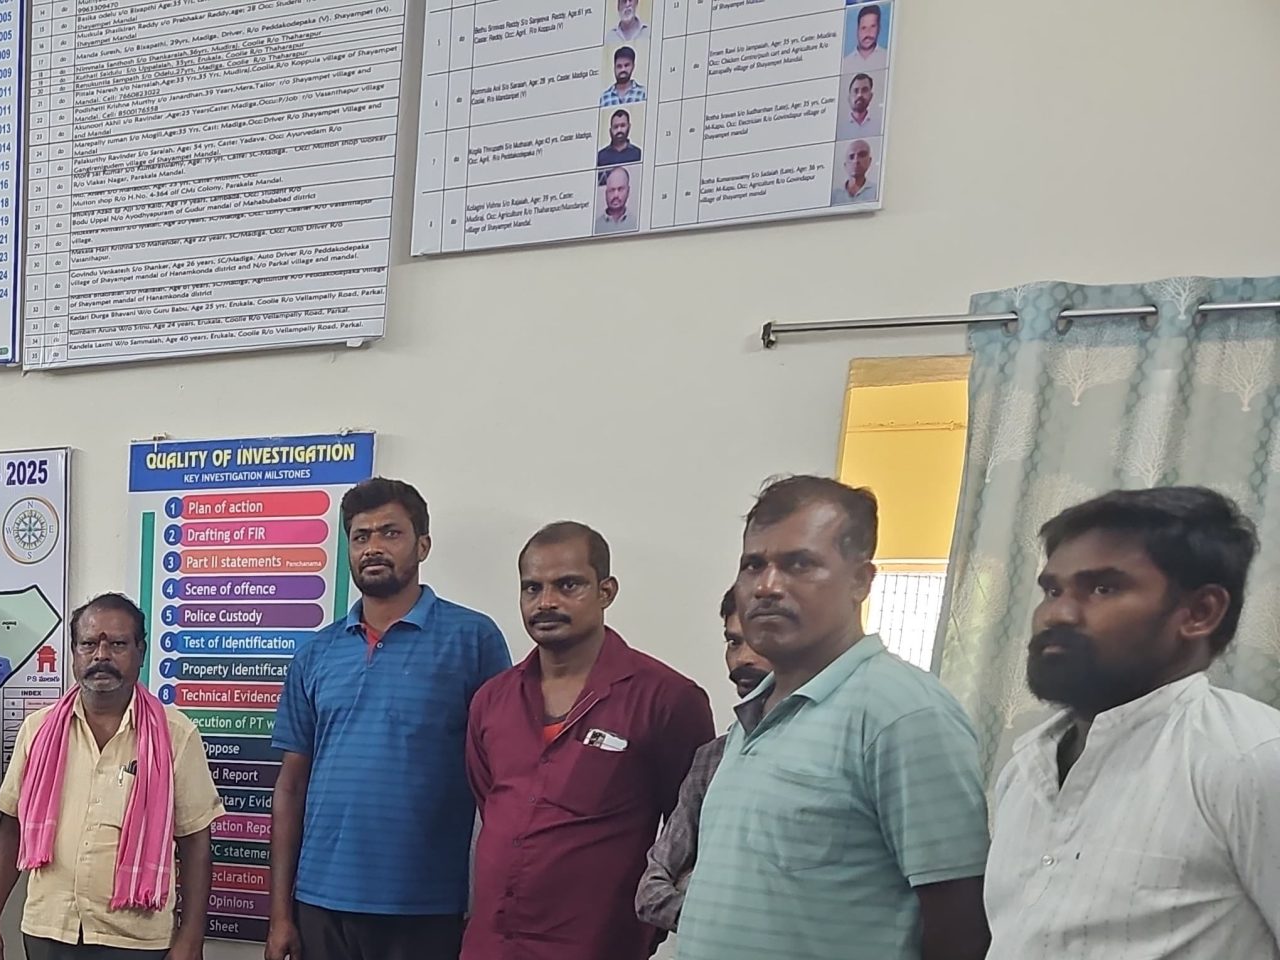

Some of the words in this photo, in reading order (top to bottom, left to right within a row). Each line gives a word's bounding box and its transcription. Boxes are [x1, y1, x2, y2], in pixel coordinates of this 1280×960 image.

[146, 450, 208, 471] QUALITY
[212, 449, 232, 469] OF
[237, 442, 356, 467] INVESTIGATION
[6, 461, 49, 486] 2025
[184, 473, 200, 484] KEY
[202, 471, 263, 483] INVESTIGATION
[265, 469, 312, 480] MILSTONES
[170, 503, 176, 513] 1
[189, 502, 212, 514] Plan
[215, 501, 227, 513] of
[229, 501, 264, 513] action
[168, 530, 176, 541] 2
[188, 529, 231, 544] Drafting
[234, 528, 245, 540] of
[248, 528, 266, 540] FIR
[168, 557, 175, 568] 3
[187, 556, 209, 568] Part
[221, 555, 282, 568] statements
[166, 584, 174, 595] 4
[185, 584, 217, 596] Scene
[220, 583, 232, 595] of
[234, 583, 276, 595] offence
[166, 611, 173, 622] 5
[184, 610, 217, 622] Police
[220, 609, 263, 625] Custody
[164, 638, 172, 648] 6
[183, 636, 206, 648] Test
[208, 636, 220, 648] of
[222, 636, 295, 649] Identification
[164, 663, 171, 674] 7
[183, 663, 228, 678] Property
[232, 664, 290, 676] Identificat
[162, 689, 170, 699] 8
[182, 689, 231, 702] Technical
[235, 717, 247, 729] of
[250, 717, 264, 729] PT
[266, 719, 275, 730] w
[202, 741, 240, 757] Oppose
[222, 770, 258, 784] Report
[249, 794, 272, 808] Evid
[211, 821, 243, 835] gation
[223, 846, 271, 859] stateme
[212, 871, 264, 886] eclaration
[209, 894, 255, 910] Opinions
[209, 919, 239, 934] Sheet
